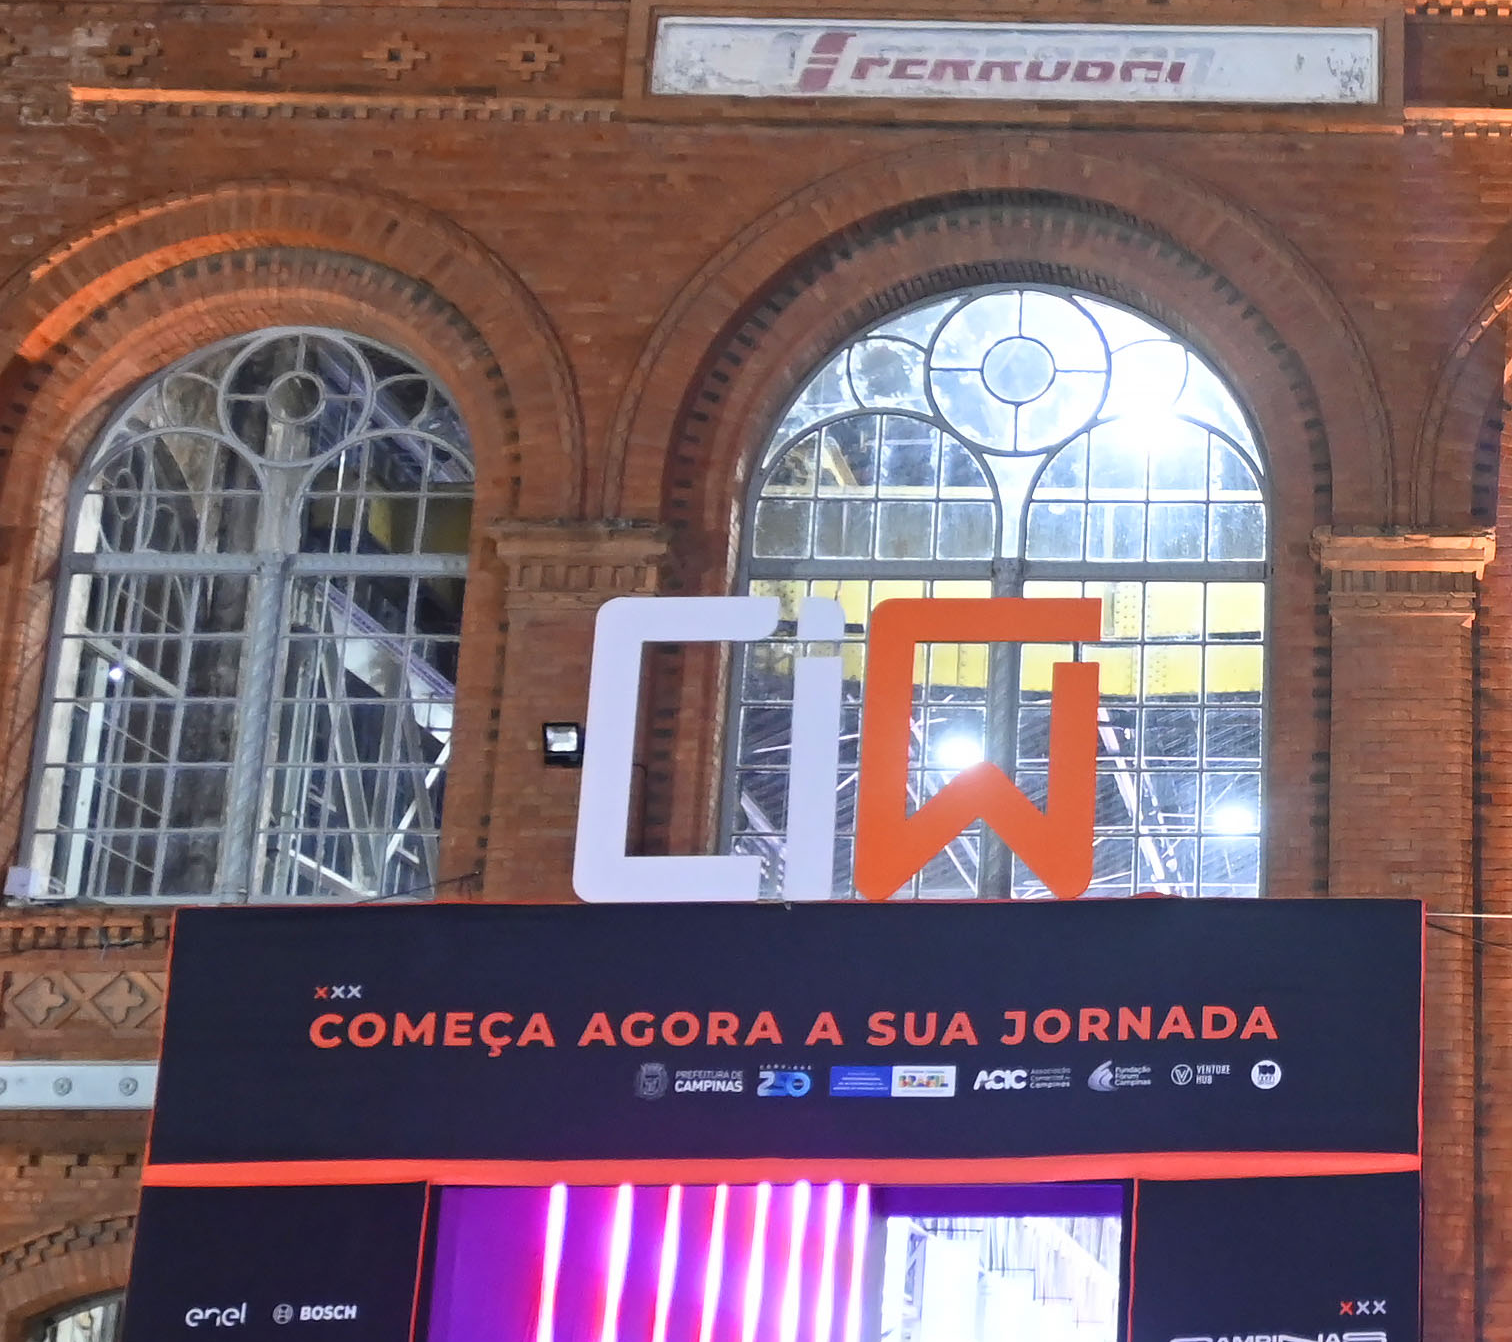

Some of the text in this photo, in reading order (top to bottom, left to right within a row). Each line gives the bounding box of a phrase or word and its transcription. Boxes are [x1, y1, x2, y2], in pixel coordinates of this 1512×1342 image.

[309, 1005, 1279, 1058] COMEÇA AGORA A SUA JORNADA
[674, 1079, 744, 1092] CAMPINAS
[973, 1069, 1027, 1090] ACIC
[185, 1302, 247, 1327] enel
[299, 1305, 357, 1321] BOSCH
